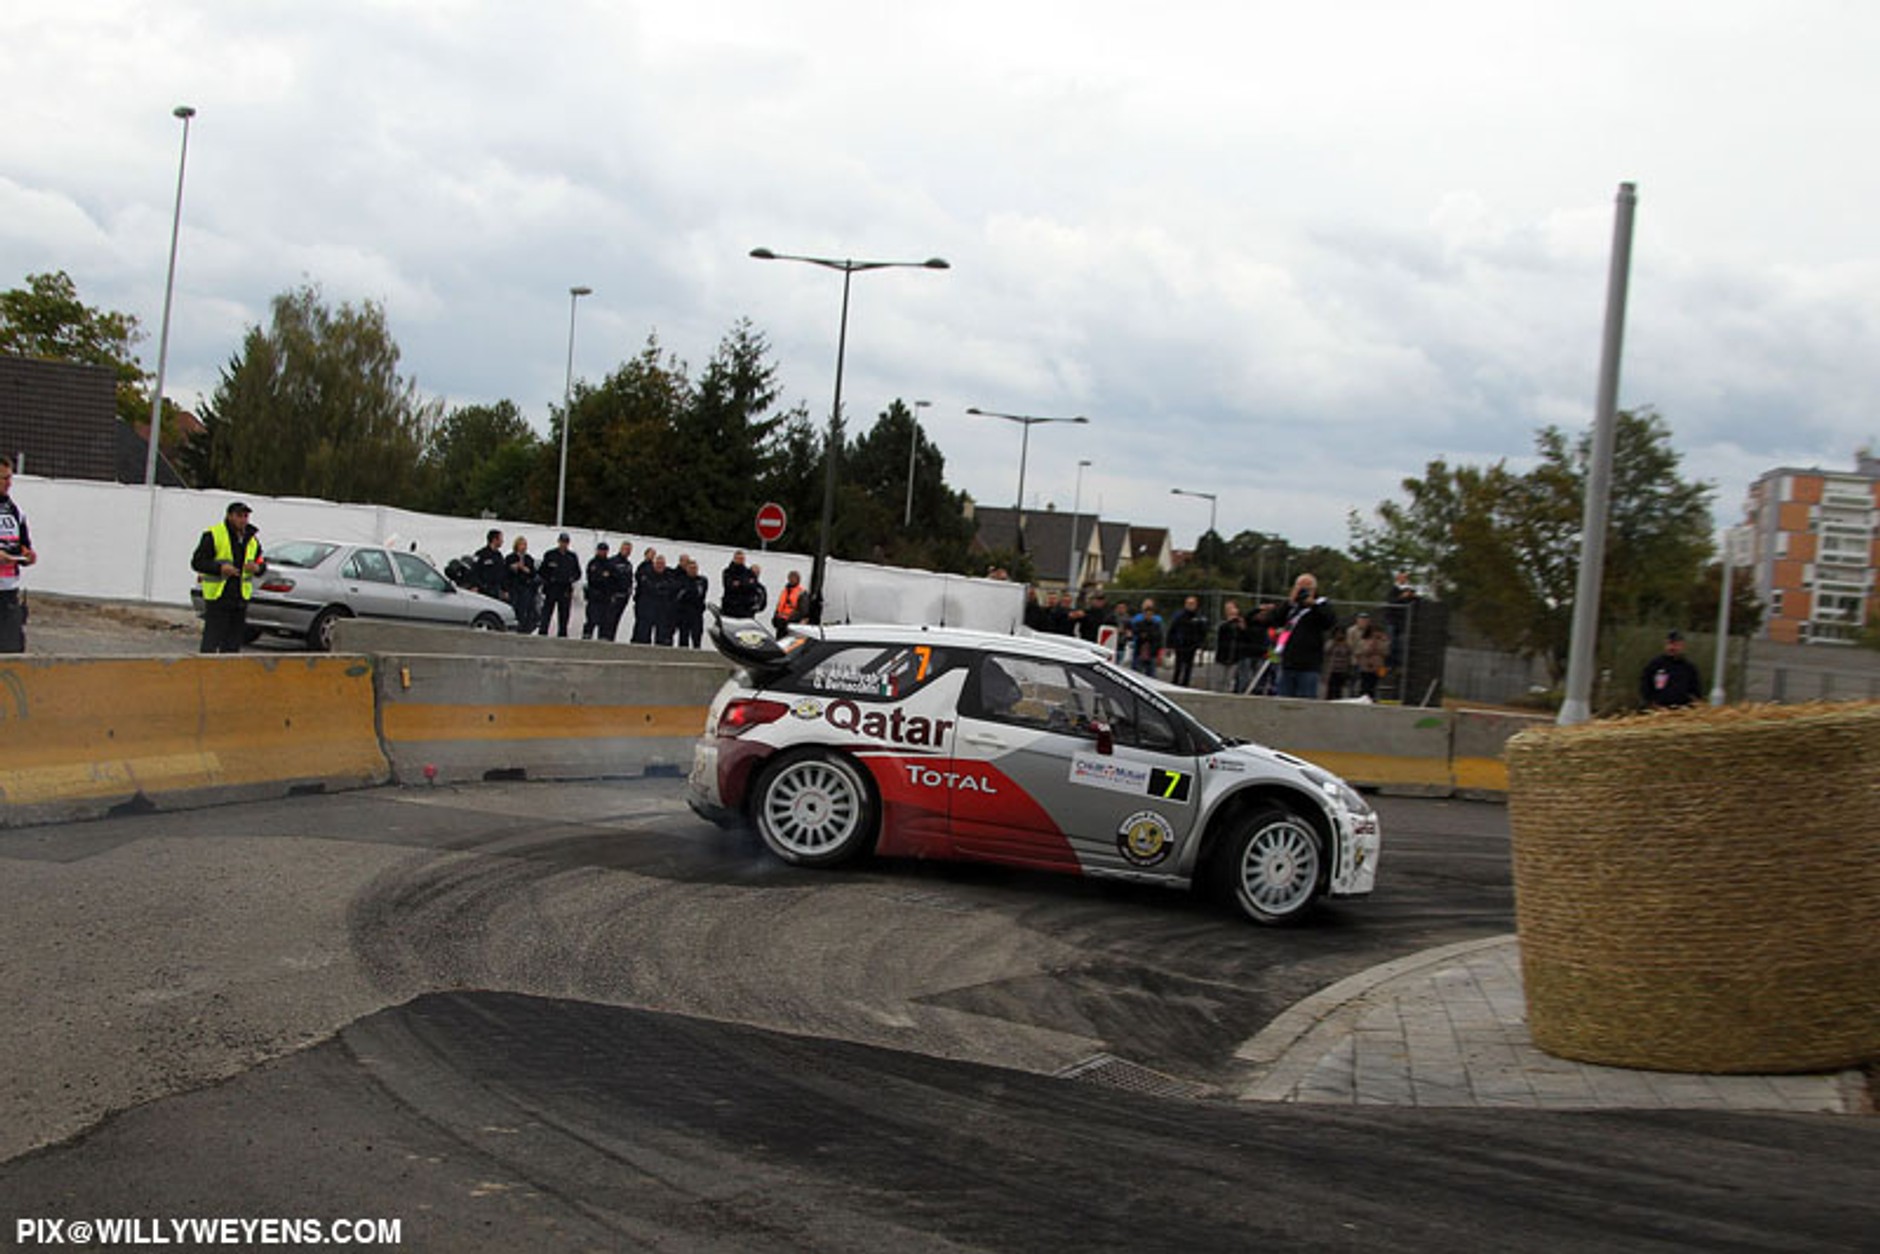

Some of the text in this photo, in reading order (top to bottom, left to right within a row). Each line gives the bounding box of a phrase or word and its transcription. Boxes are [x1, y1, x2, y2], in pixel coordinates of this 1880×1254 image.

[914, 646, 932, 681] 7
[825, 699, 953, 747] Qatar
[1163, 770, 1181, 798] 7
